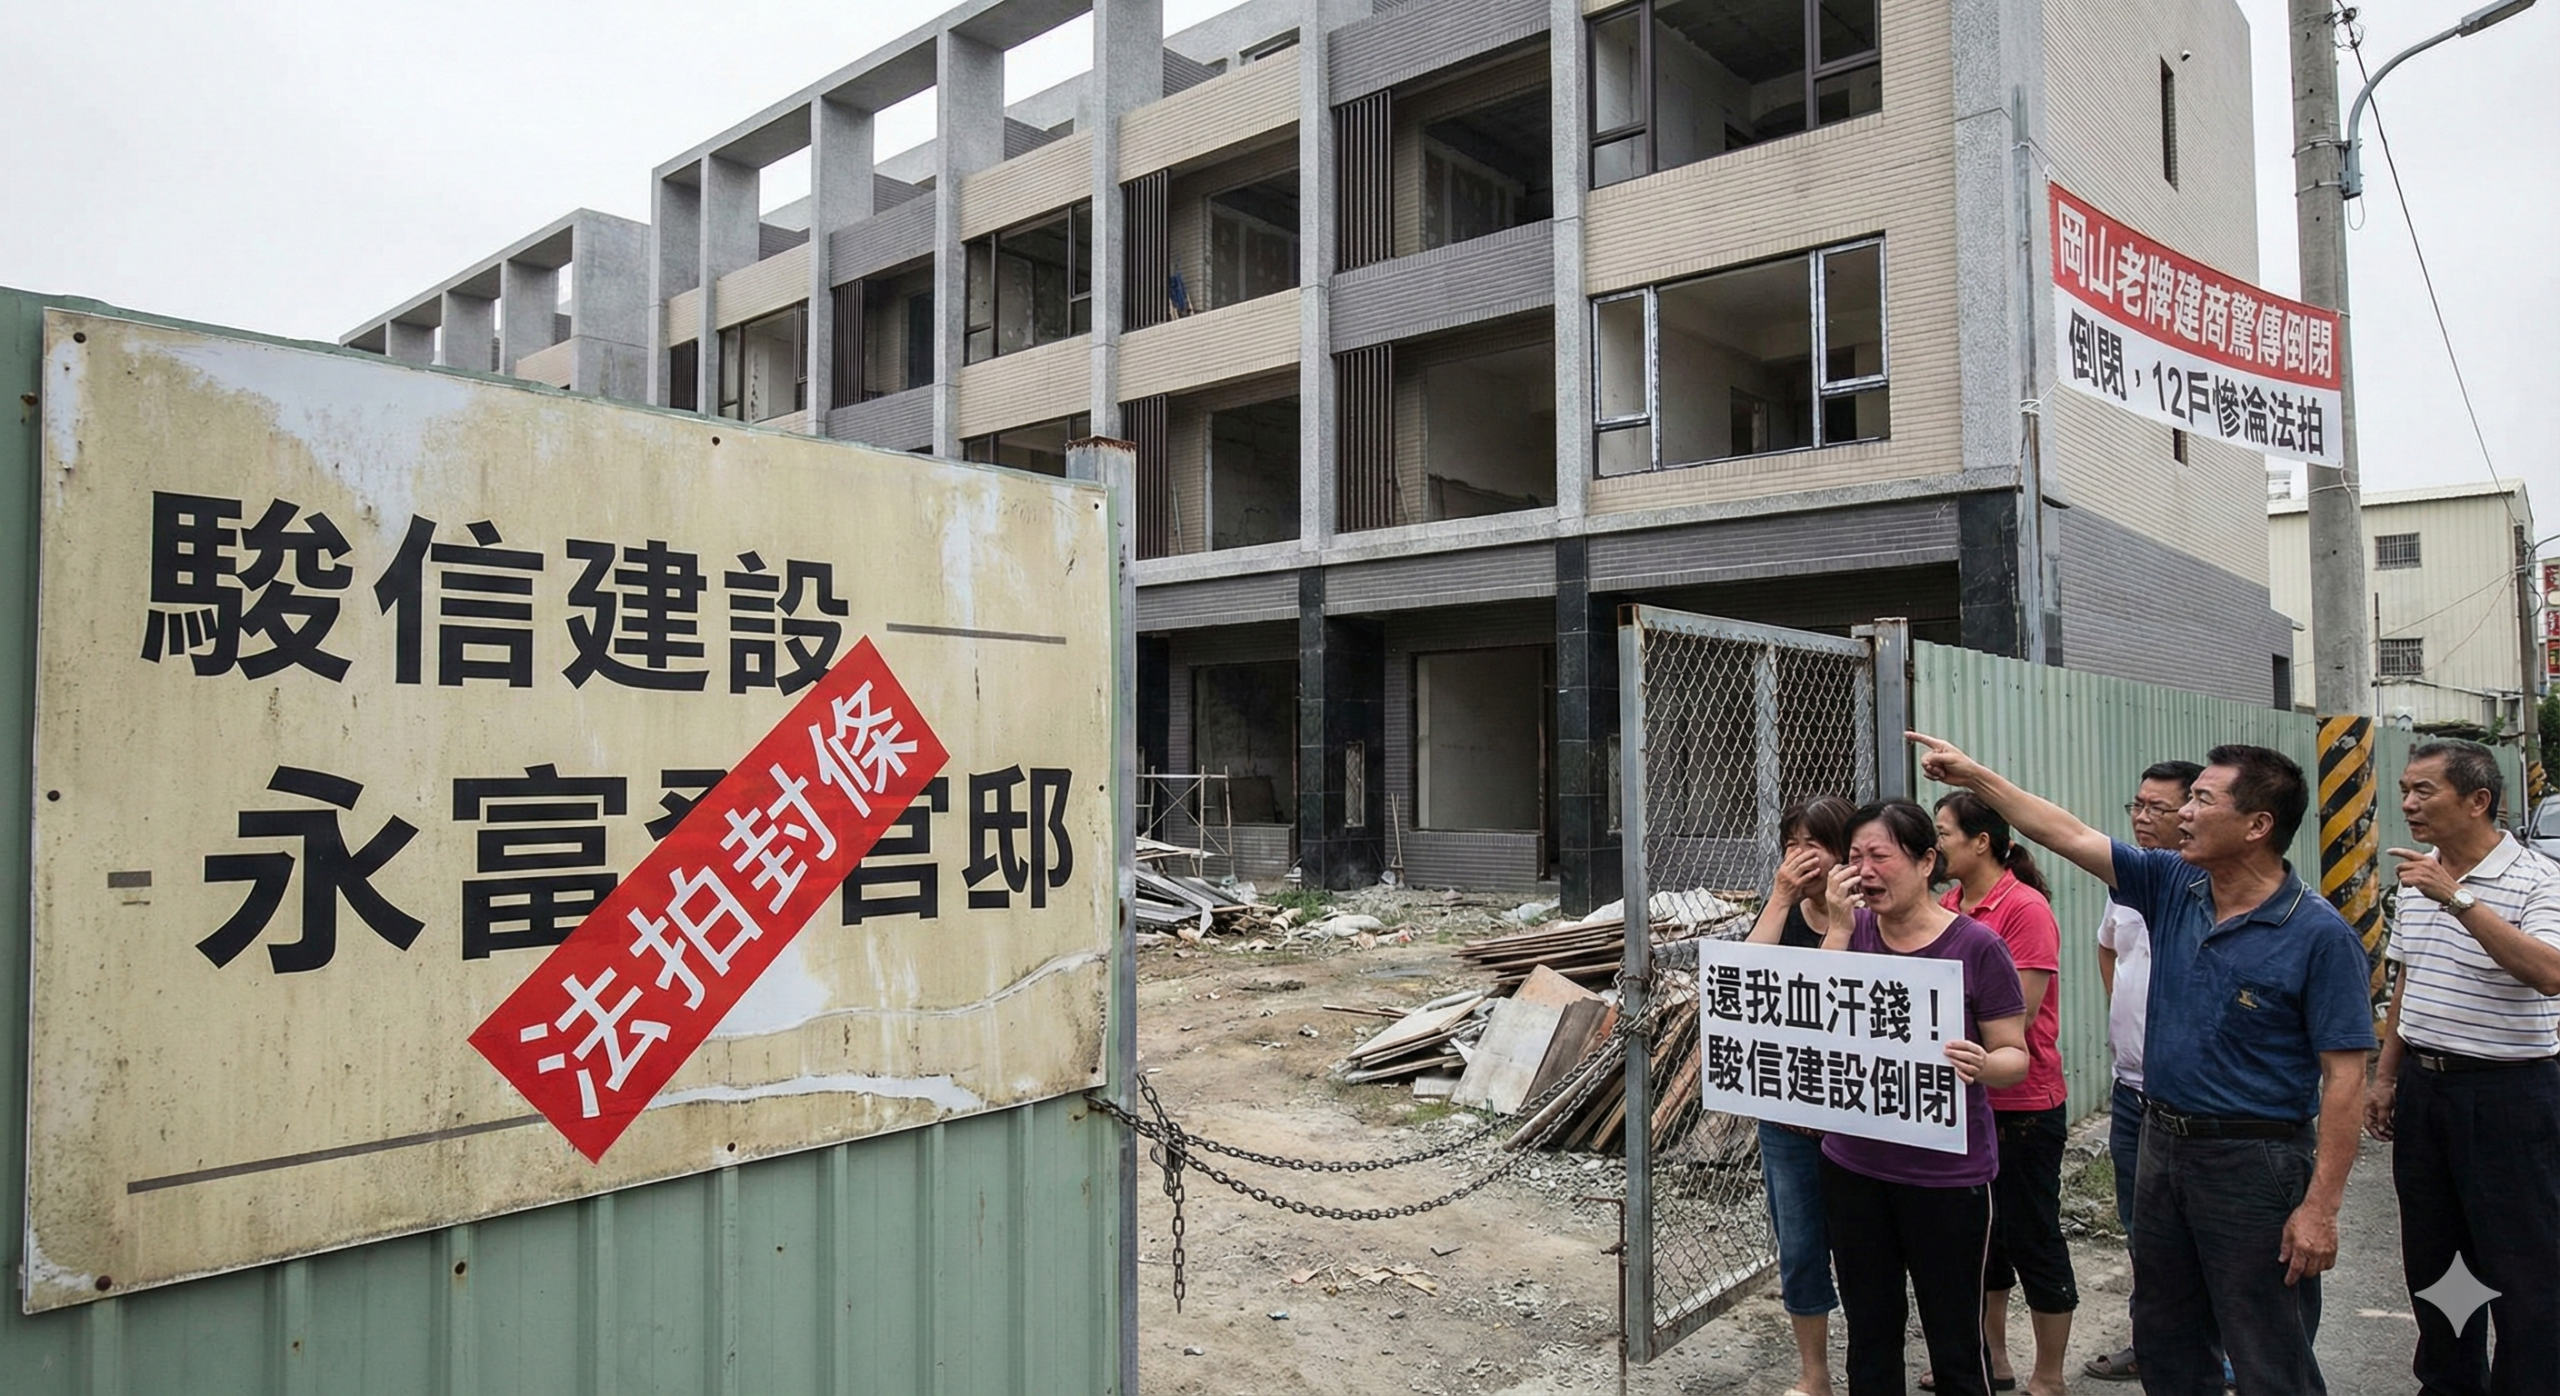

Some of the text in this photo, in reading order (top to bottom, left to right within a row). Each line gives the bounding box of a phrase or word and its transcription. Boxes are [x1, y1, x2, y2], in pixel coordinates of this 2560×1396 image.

[2057, 200, 2332, 379] 岡山老牌建商驚傳倒閉
[141, 490, 849, 697] 駿信建設
[519, 679, 919, 1118] 法拍封條
[1707, 964, 1941, 1044] 還我血汗錢！
[1708, 1034, 1957, 1128] 駿信建設倒閉
